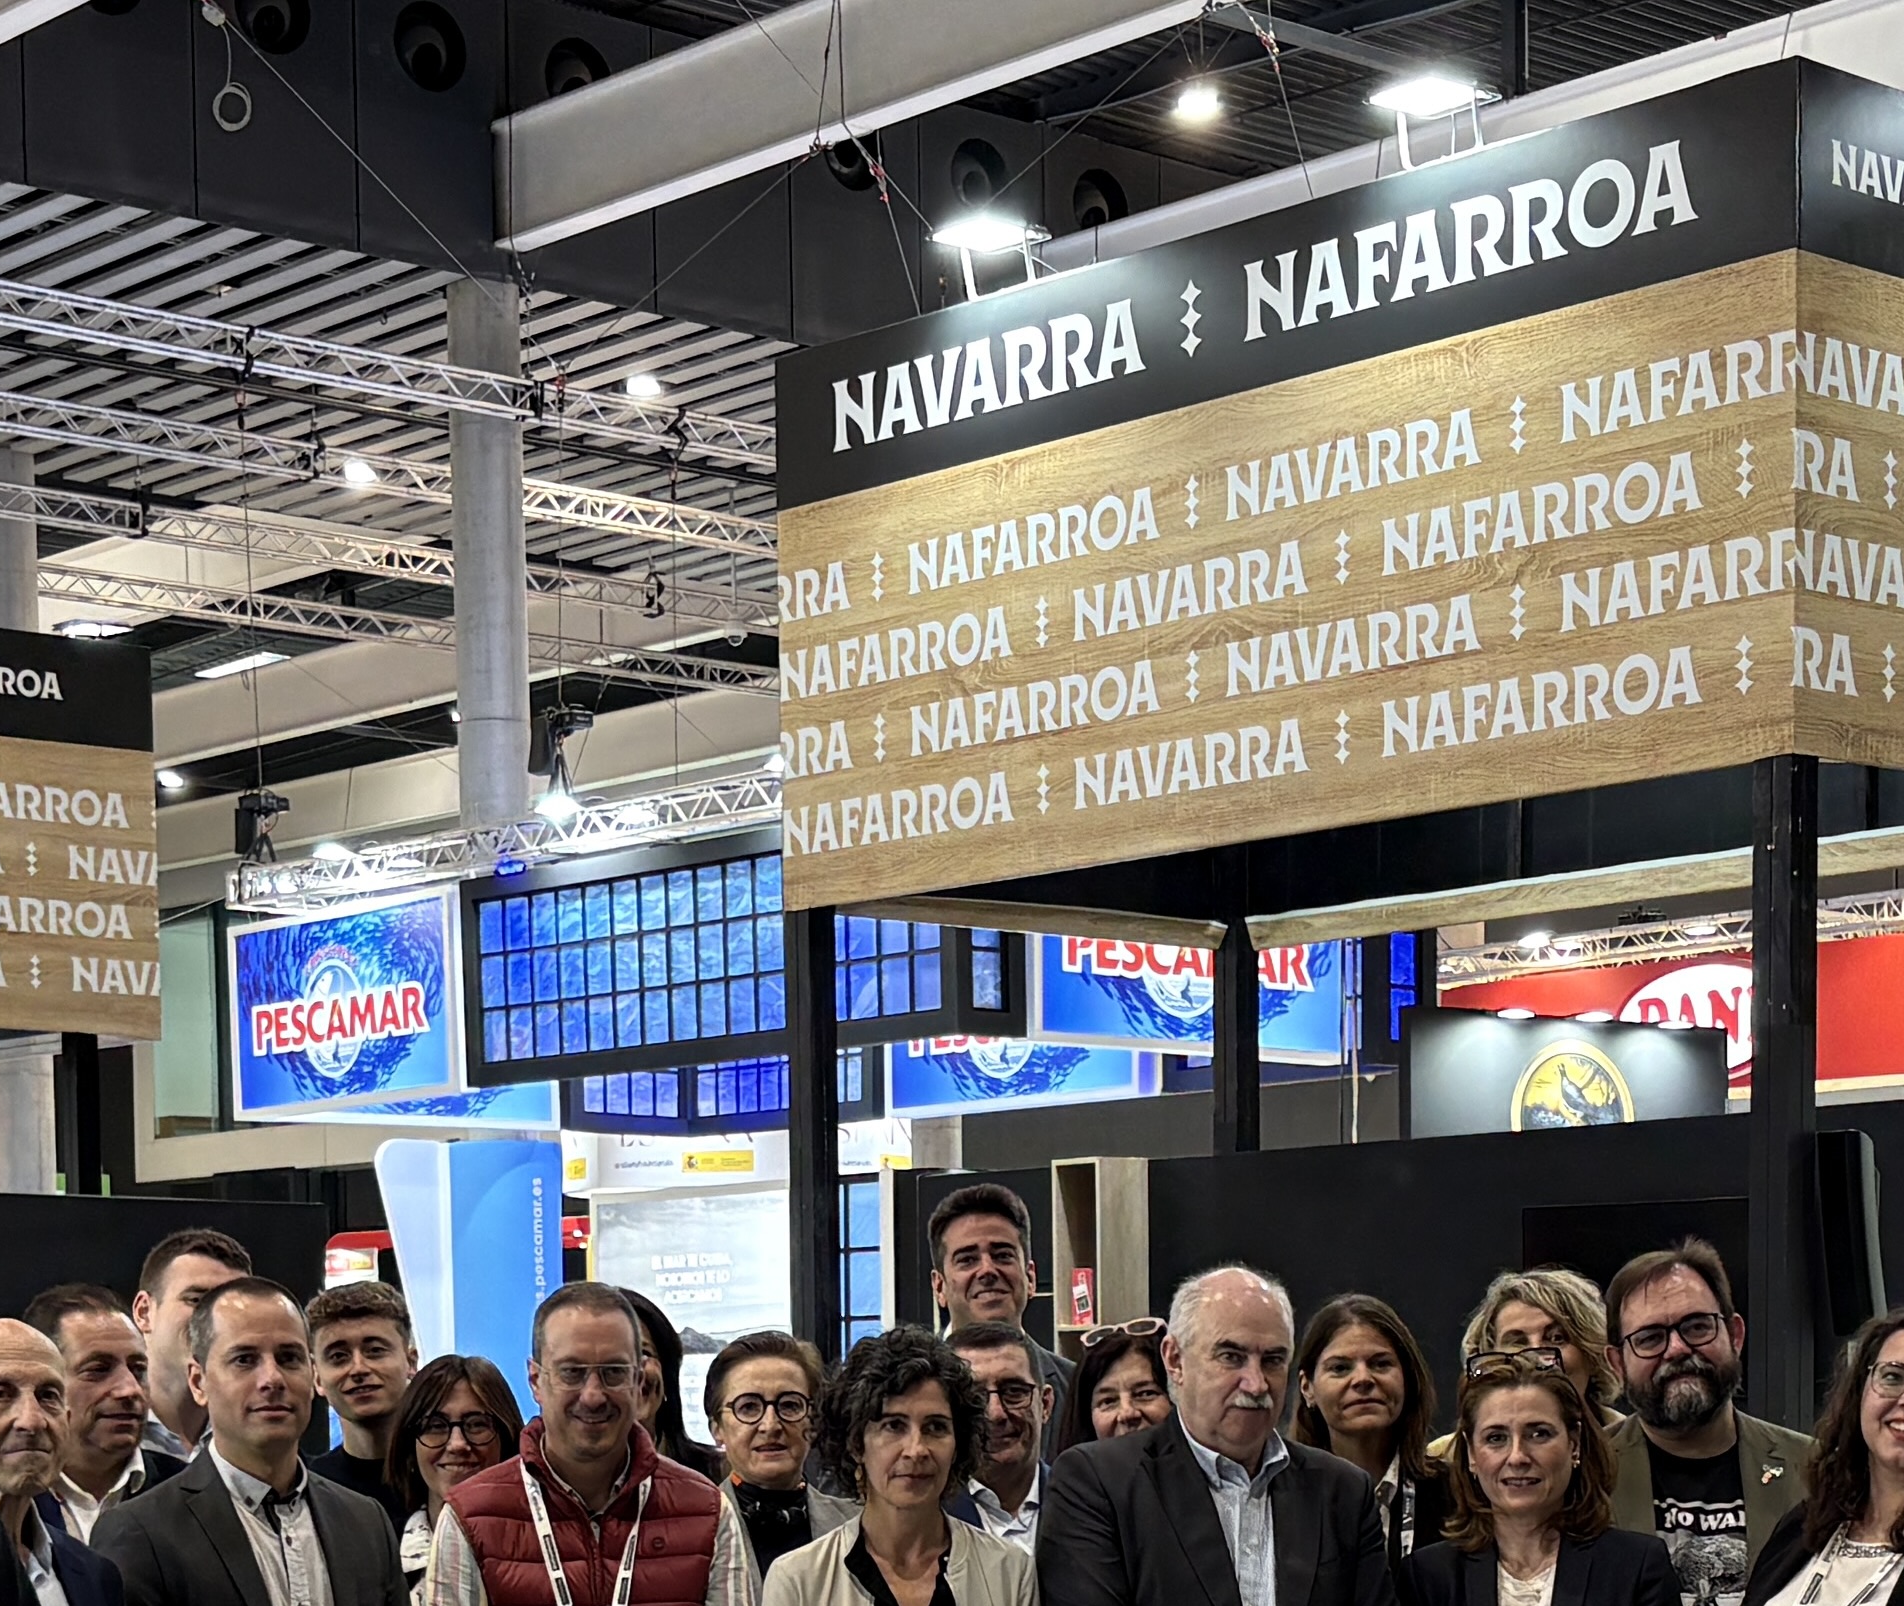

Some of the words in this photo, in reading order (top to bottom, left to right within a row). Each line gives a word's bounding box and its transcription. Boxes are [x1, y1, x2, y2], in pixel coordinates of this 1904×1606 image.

[832, 298, 1146, 453] NAVARRA
[1243, 139, 1699, 343] NAFARROA
[779, 604, 1012, 702] NAFARROA
[1072, 539, 1308, 641] NAVARRA
[1381, 451, 1701, 576] NAFARROA
[907, 485, 1159, 595] NAFARROA
[1225, 407, 1480, 521] NAVARRA
[783, 770, 1014, 858] NAFARROA
[1073, 717, 1308, 810] NAVARRA
[1381, 645, 1701, 758] NAFARROA
[909, 658, 1160, 756] NAFARROA
[1225, 593, 1480, 697] NAVARRA
[255, 986, 426, 1051] PESCAMAR
[1066, 936, 1310, 987] PESCAAR
[1637, 986, 1754, 1045] DAN
[1664, 1507, 1694, 1529] NO
